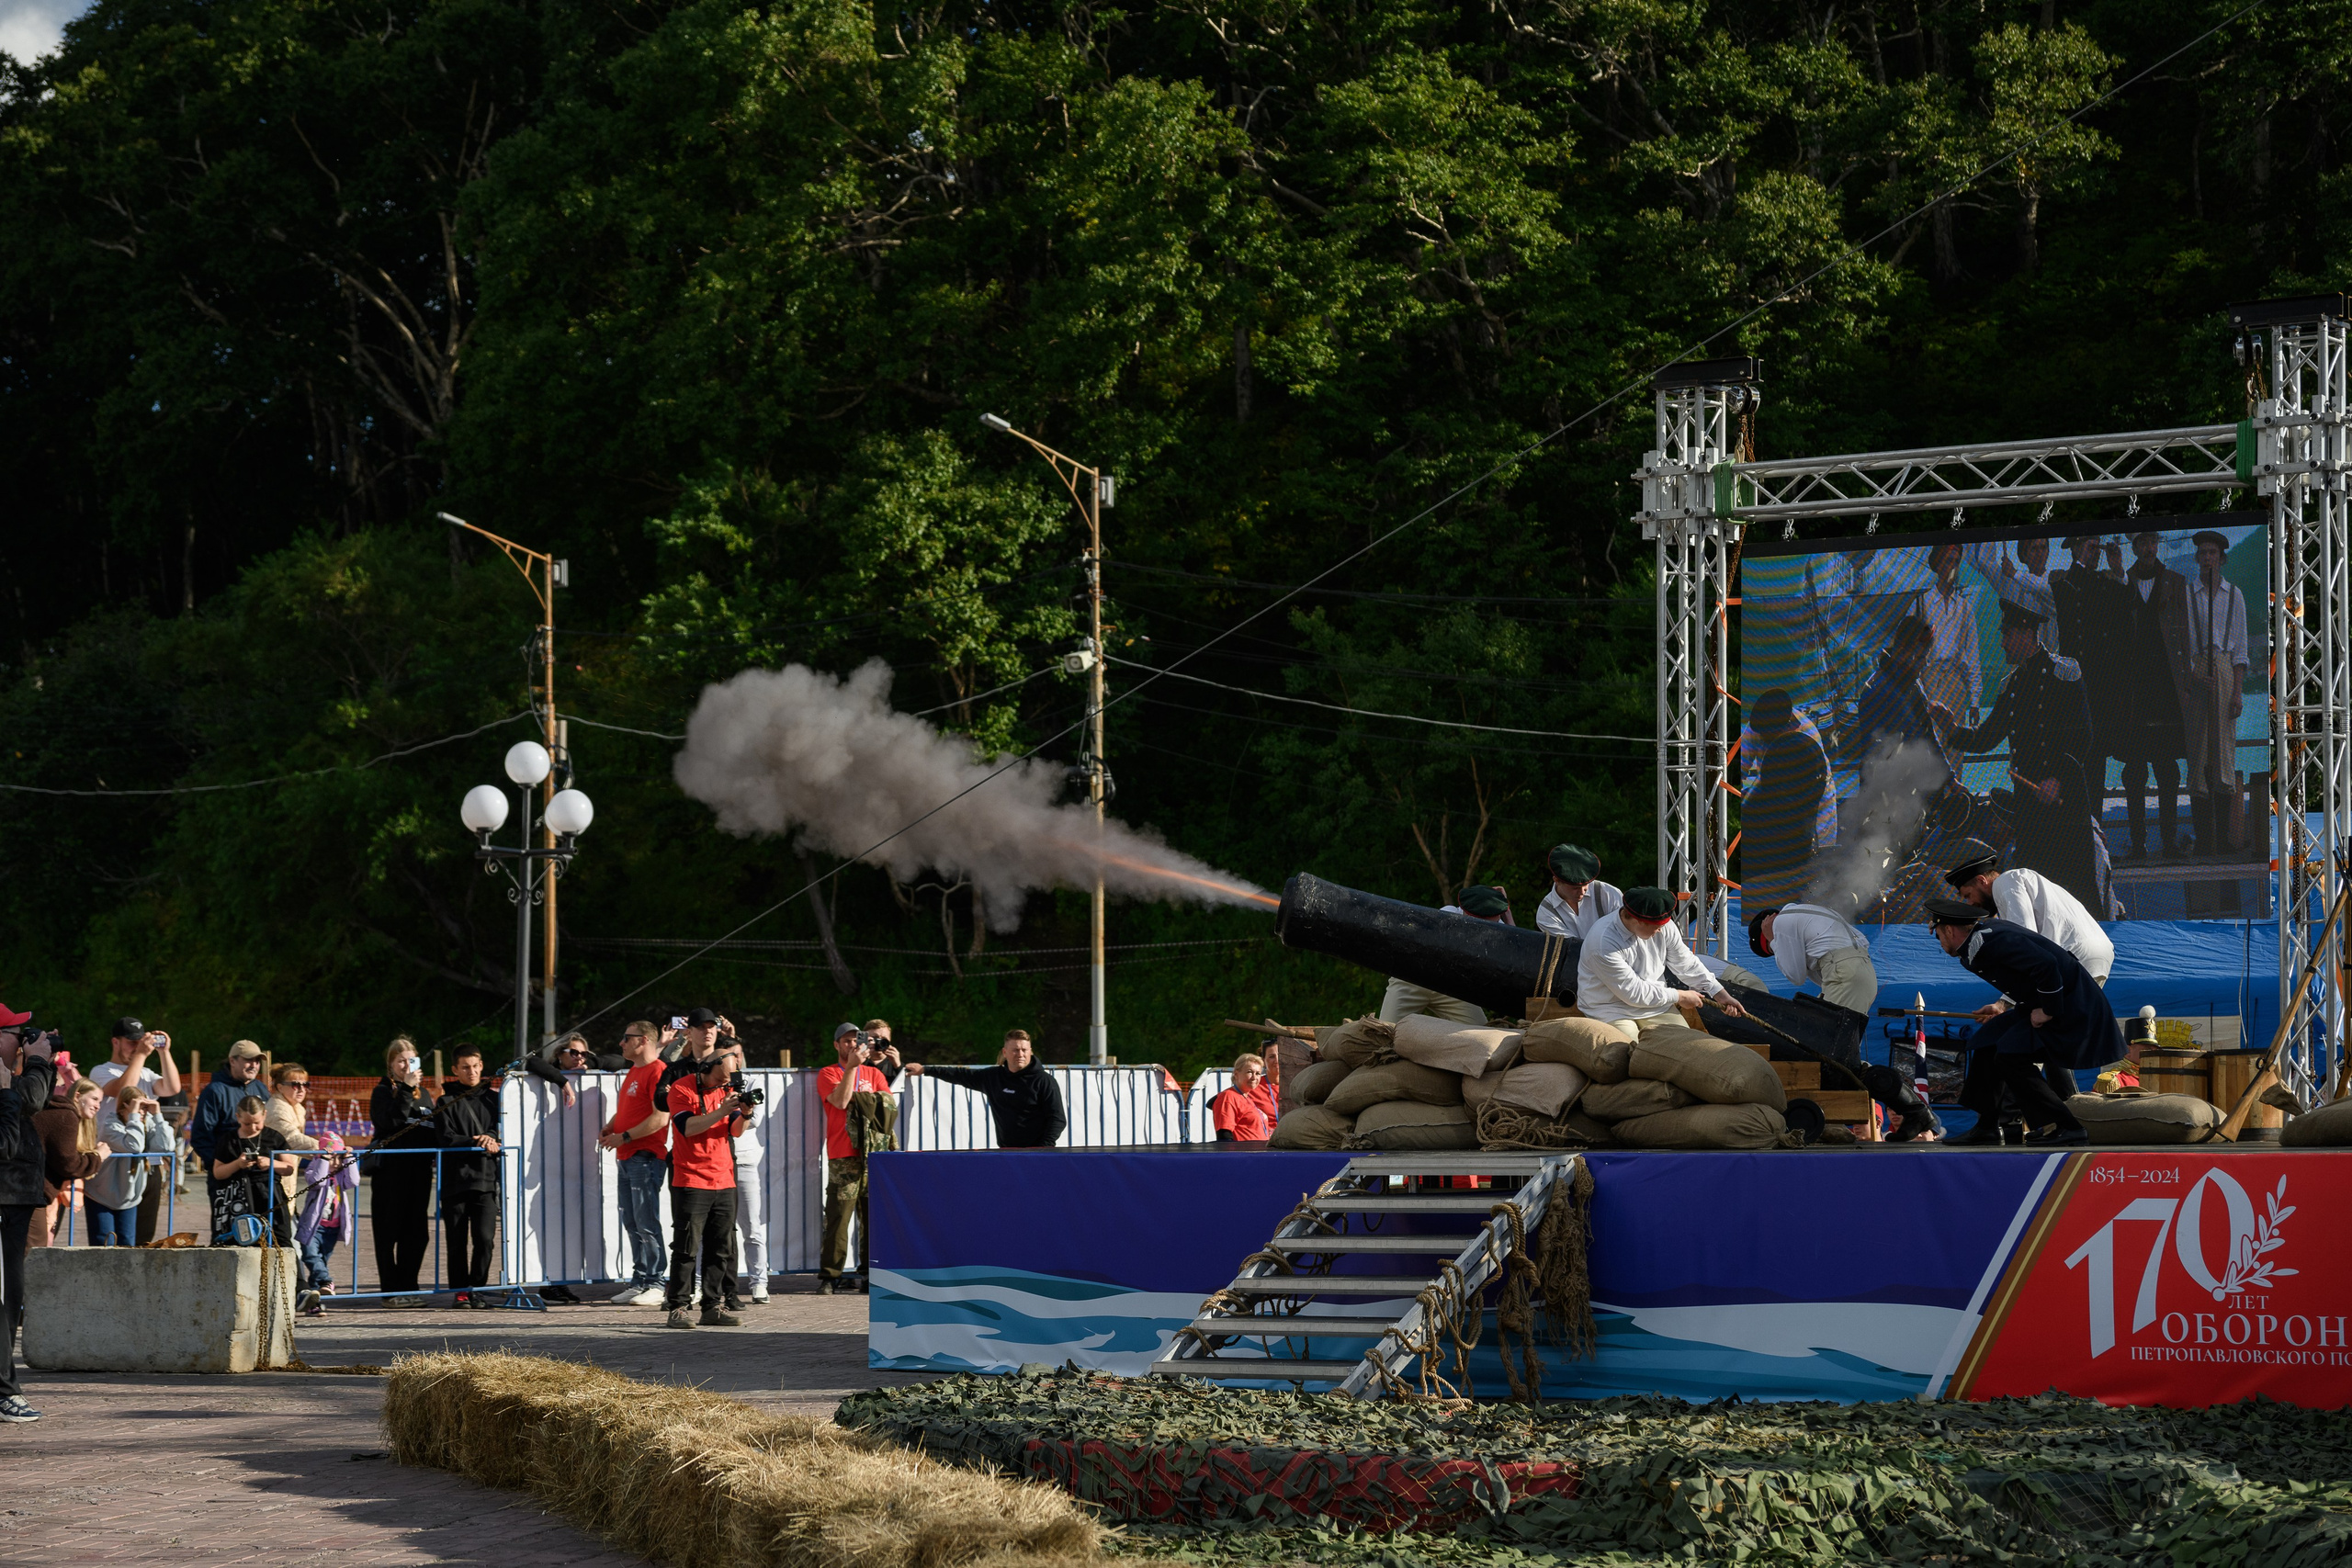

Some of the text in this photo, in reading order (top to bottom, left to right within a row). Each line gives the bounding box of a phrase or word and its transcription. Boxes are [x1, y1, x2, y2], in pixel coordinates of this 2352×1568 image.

[2064, 1167, 2256, 1359] 170
[2227, 1294, 2269, 1310] ЛЕТ
[2161, 1311, 2349, 1348] ОБОРОН
[2131, 1347, 2325, 1366] ПЕТРОПАВЛОВСКОГО
